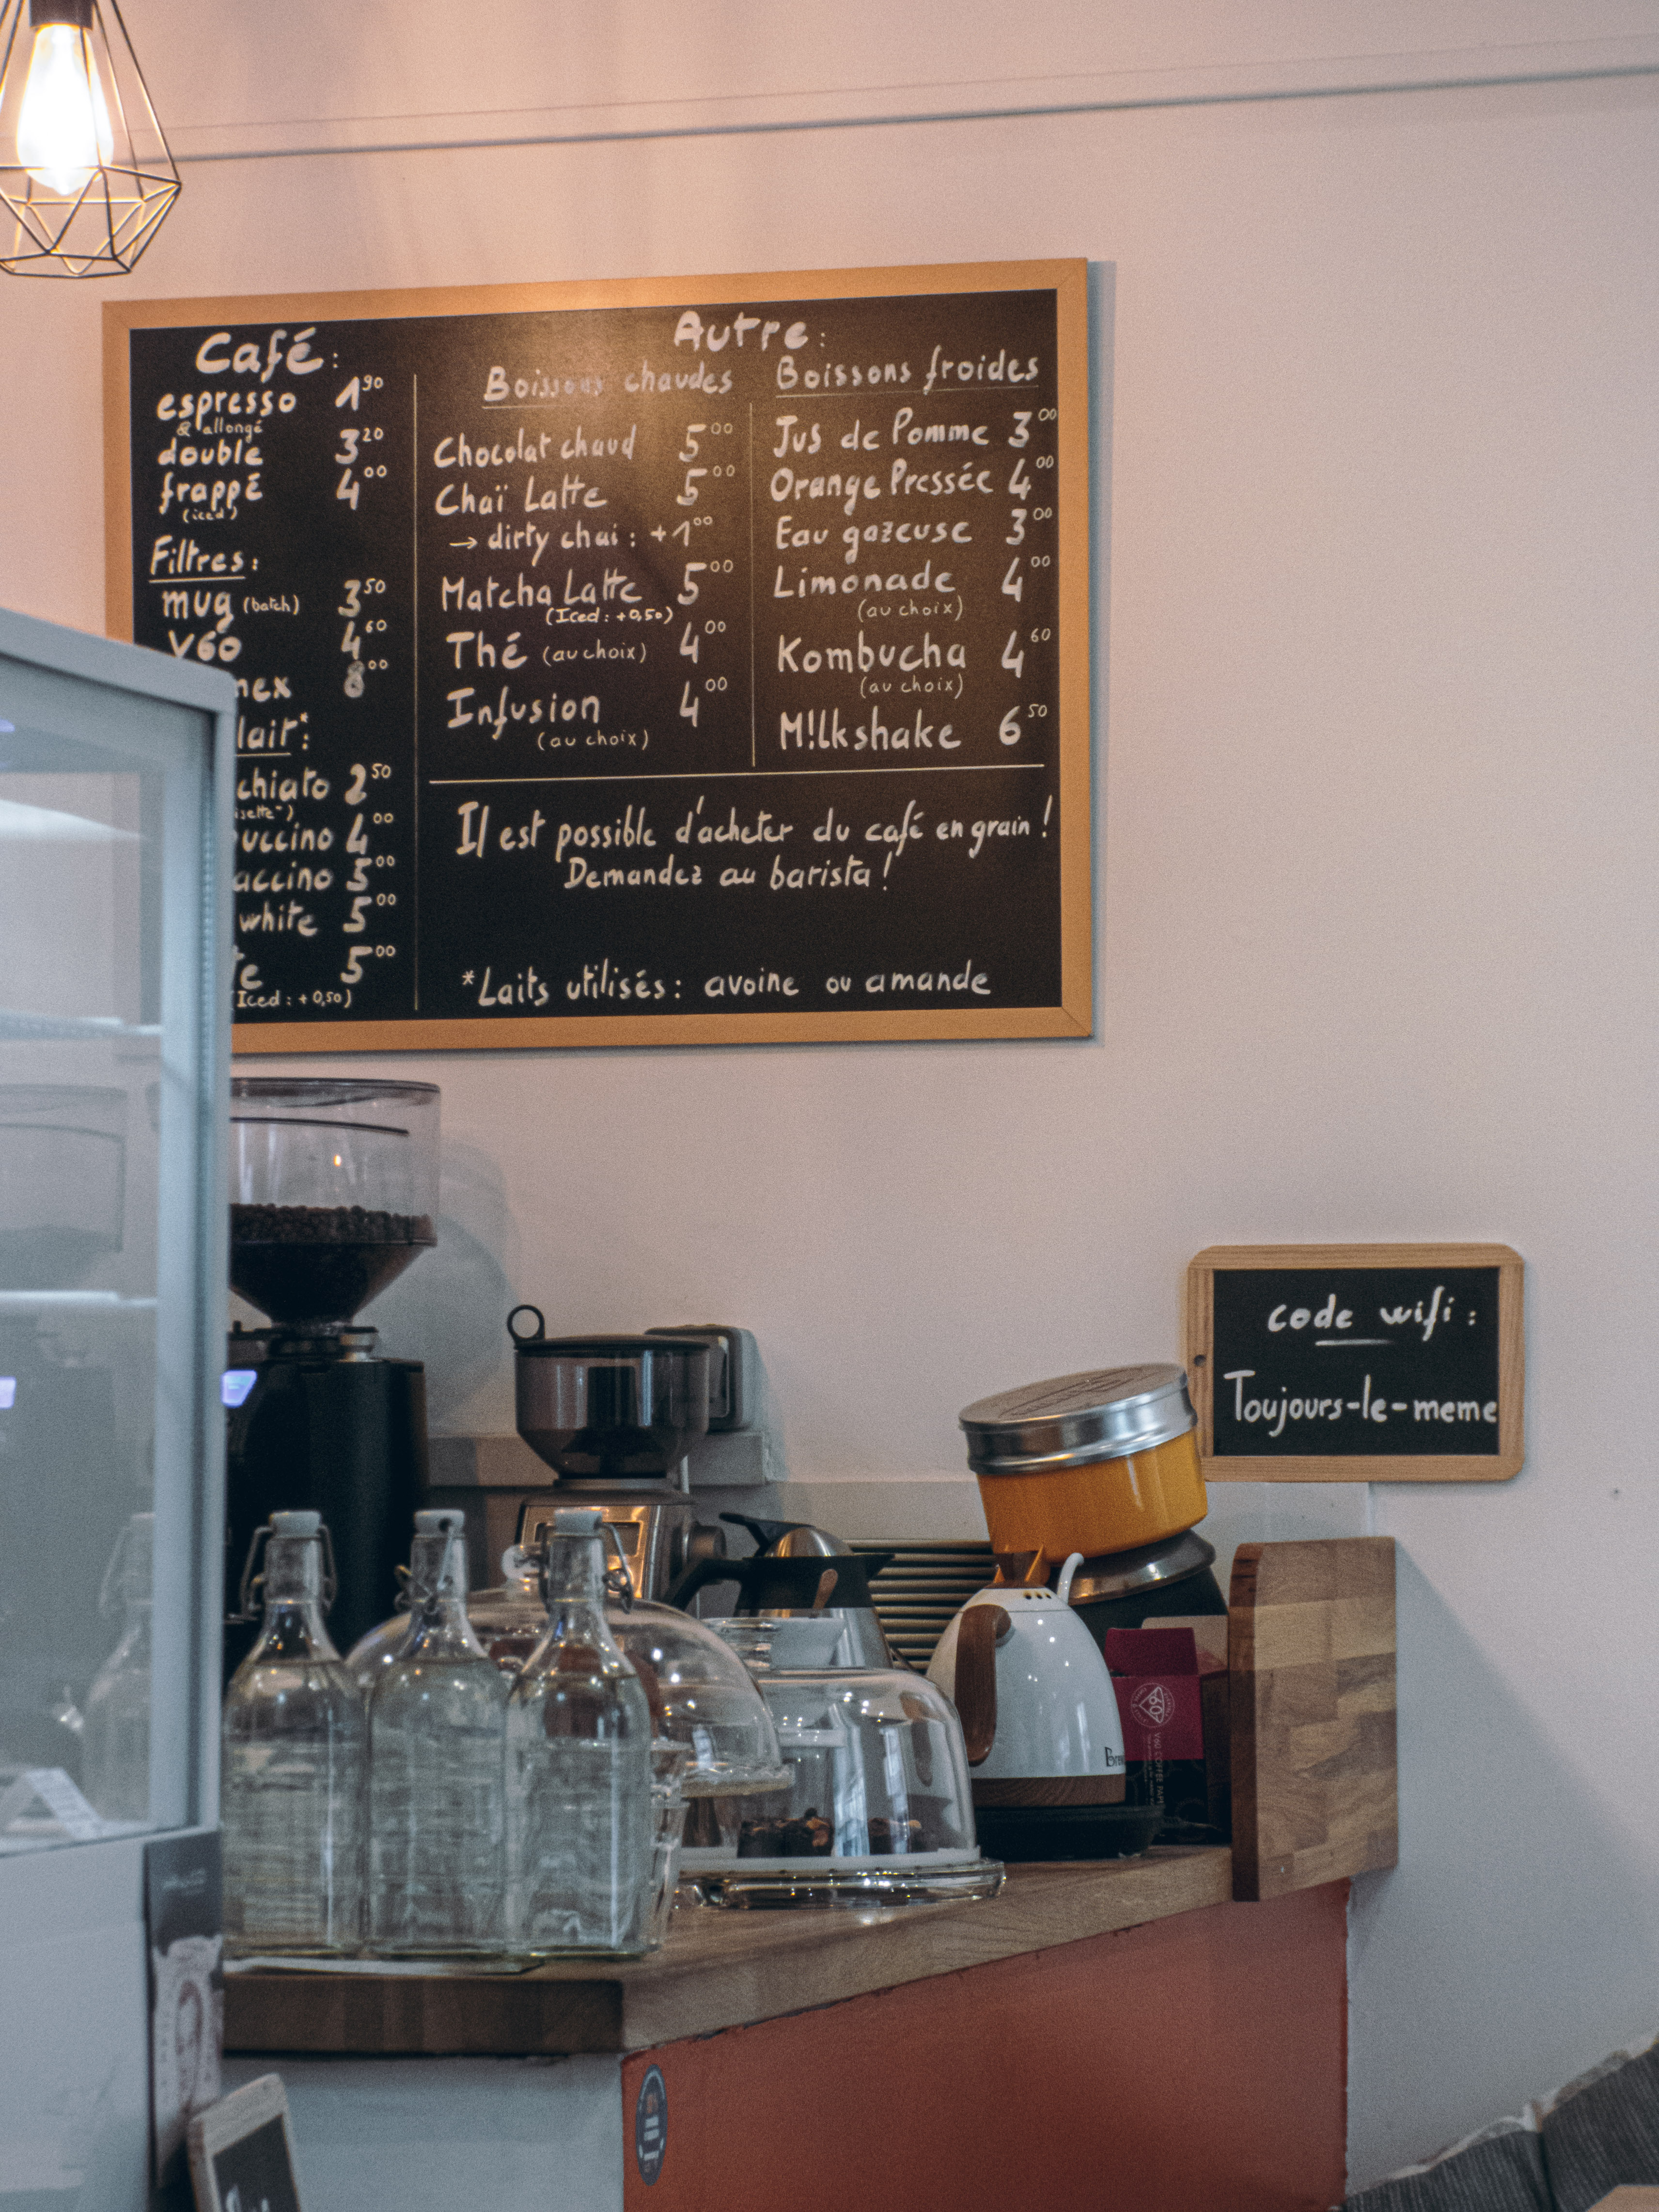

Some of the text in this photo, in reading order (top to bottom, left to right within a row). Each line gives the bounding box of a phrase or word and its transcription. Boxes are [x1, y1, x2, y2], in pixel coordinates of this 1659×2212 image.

[484, 360, 732, 402] Boissons chaudes
[776, 345, 1039, 395] Boissons froides
[157, 391, 296, 432] espresso
[203, 418, 262, 445] allongé
[158, 435, 263, 466] double
[434, 427, 553, 468] Chocolat
[561, 424, 636, 460] chaud
[773, 415, 821, 457] Jus
[841, 420, 879, 450] de
[892, 407, 988, 445] Pomme
[159, 472, 262, 517] frappé
[525, 474, 607, 512] Latte
[770, 468, 880, 516] Orange
[891, 458, 993, 495] Pressée
[183, 504, 237, 523] (iced)
[488, 522, 549, 566] dirty
[776, 516, 828, 549] Eau
[843, 522, 972, 567] gazeuse
[442, 573, 554, 614] Matcha
[564, 569, 642, 605] Latte
[774, 557, 955, 597] Limonade
[162, 591, 234, 633] mug
[243, 595, 299, 615] (batch)
[857, 595, 963, 623] (au choix)
[166, 630, 241, 664] V60
[446, 631, 527, 669] Thé
[543, 646, 578, 666] (au
[583, 639, 646, 663] choix)
[778, 630, 966, 673] Kombucha
[860, 673, 964, 699] (au choix)
[447, 686, 602, 743] Infusion
[537, 730, 648, 751] (au choix)
[456, 801, 489, 857] Il
[500, 810, 546, 850] est
[555, 805, 656, 865] possible
[676, 796, 793, 844] d'acheter
[813, 808, 849, 842] du
[865, 800, 923, 859] café
[937, 820, 963, 840] en
[564, 854, 702, 888] Demandez
[720, 868, 755, 886] au
[240, 901, 317, 936] white
[704, 968, 798, 997] avoine
[826, 977, 851, 993] ou
[865, 960, 990, 994] amande
[1268, 1294, 1352, 1332] code
[1224, 1370, 1497, 1437] Toujours-le-meme
[1157, 1785, 1165, 1804] PAP
